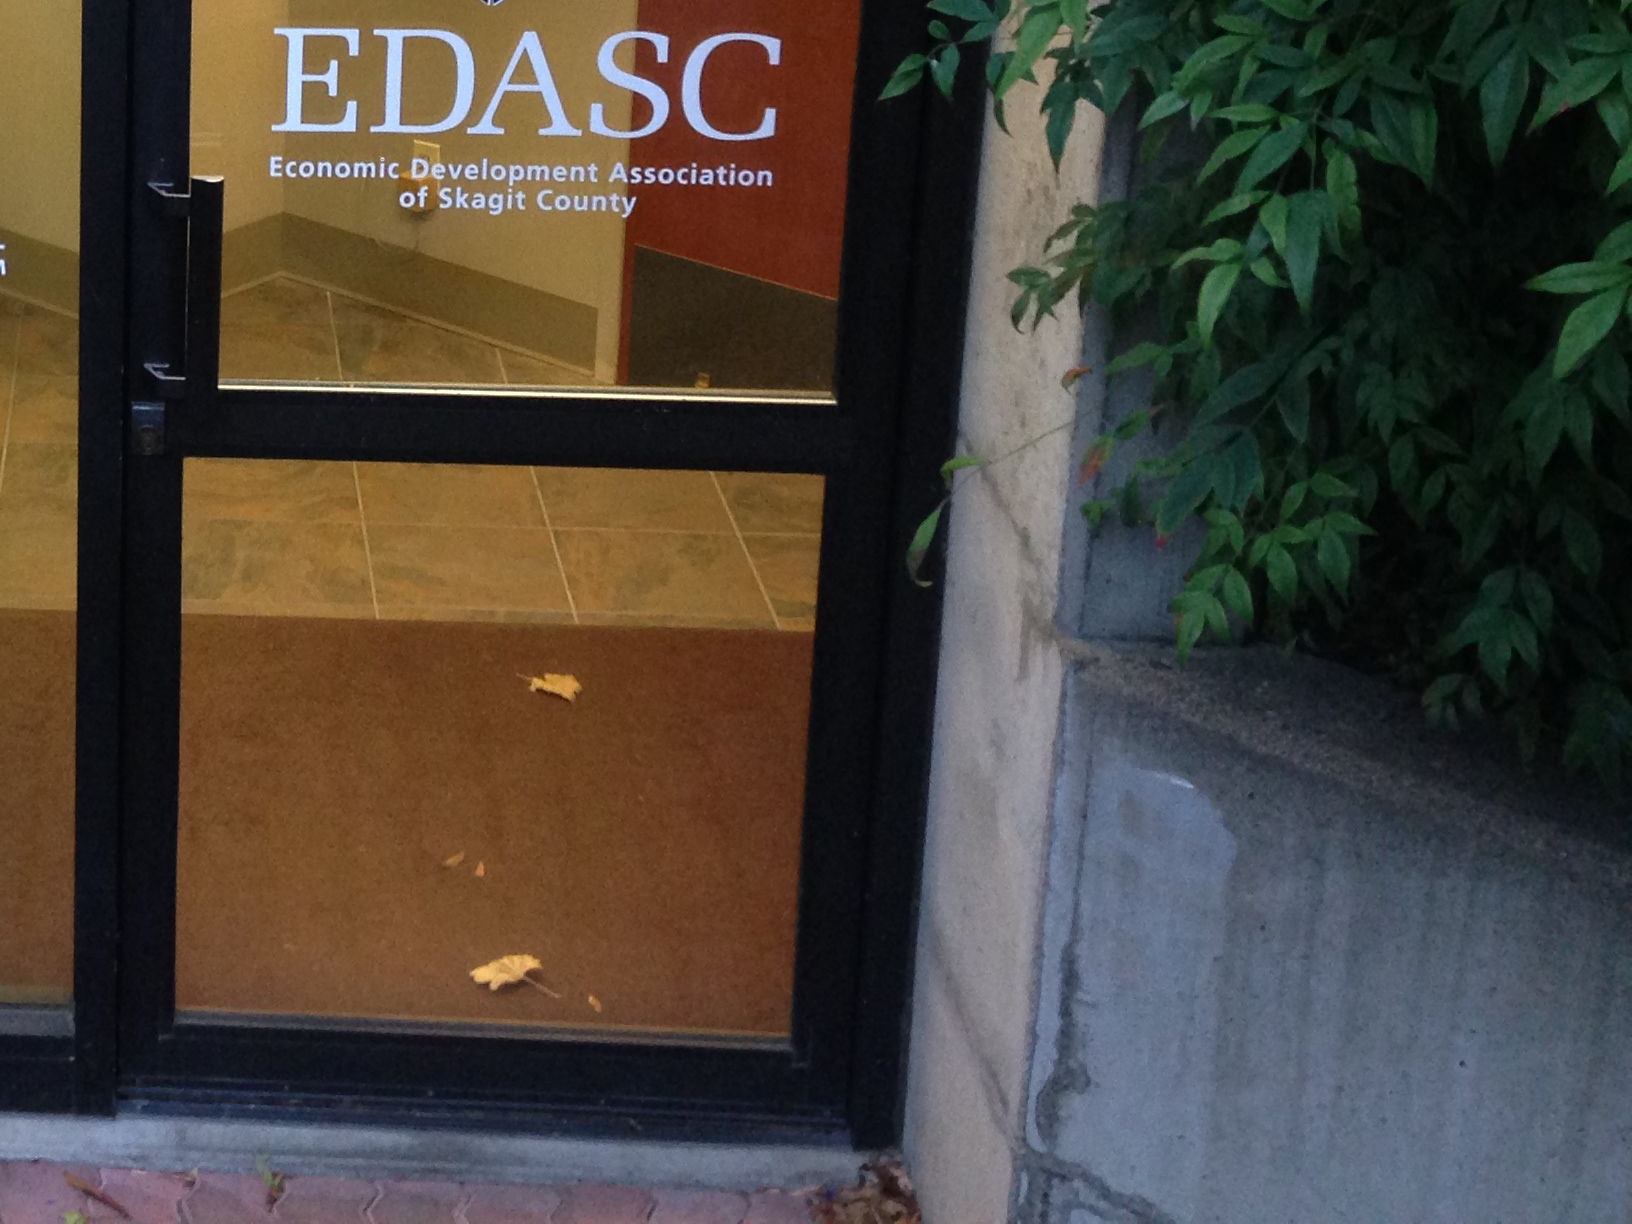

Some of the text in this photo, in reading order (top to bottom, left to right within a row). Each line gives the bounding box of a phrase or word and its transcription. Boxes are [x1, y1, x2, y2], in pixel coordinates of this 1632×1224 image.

[271, 26, 782, 142] EDASC
[268, 155, 774, 187] Economic Development Association
[399, 187, 638, 218] of Skagit County
